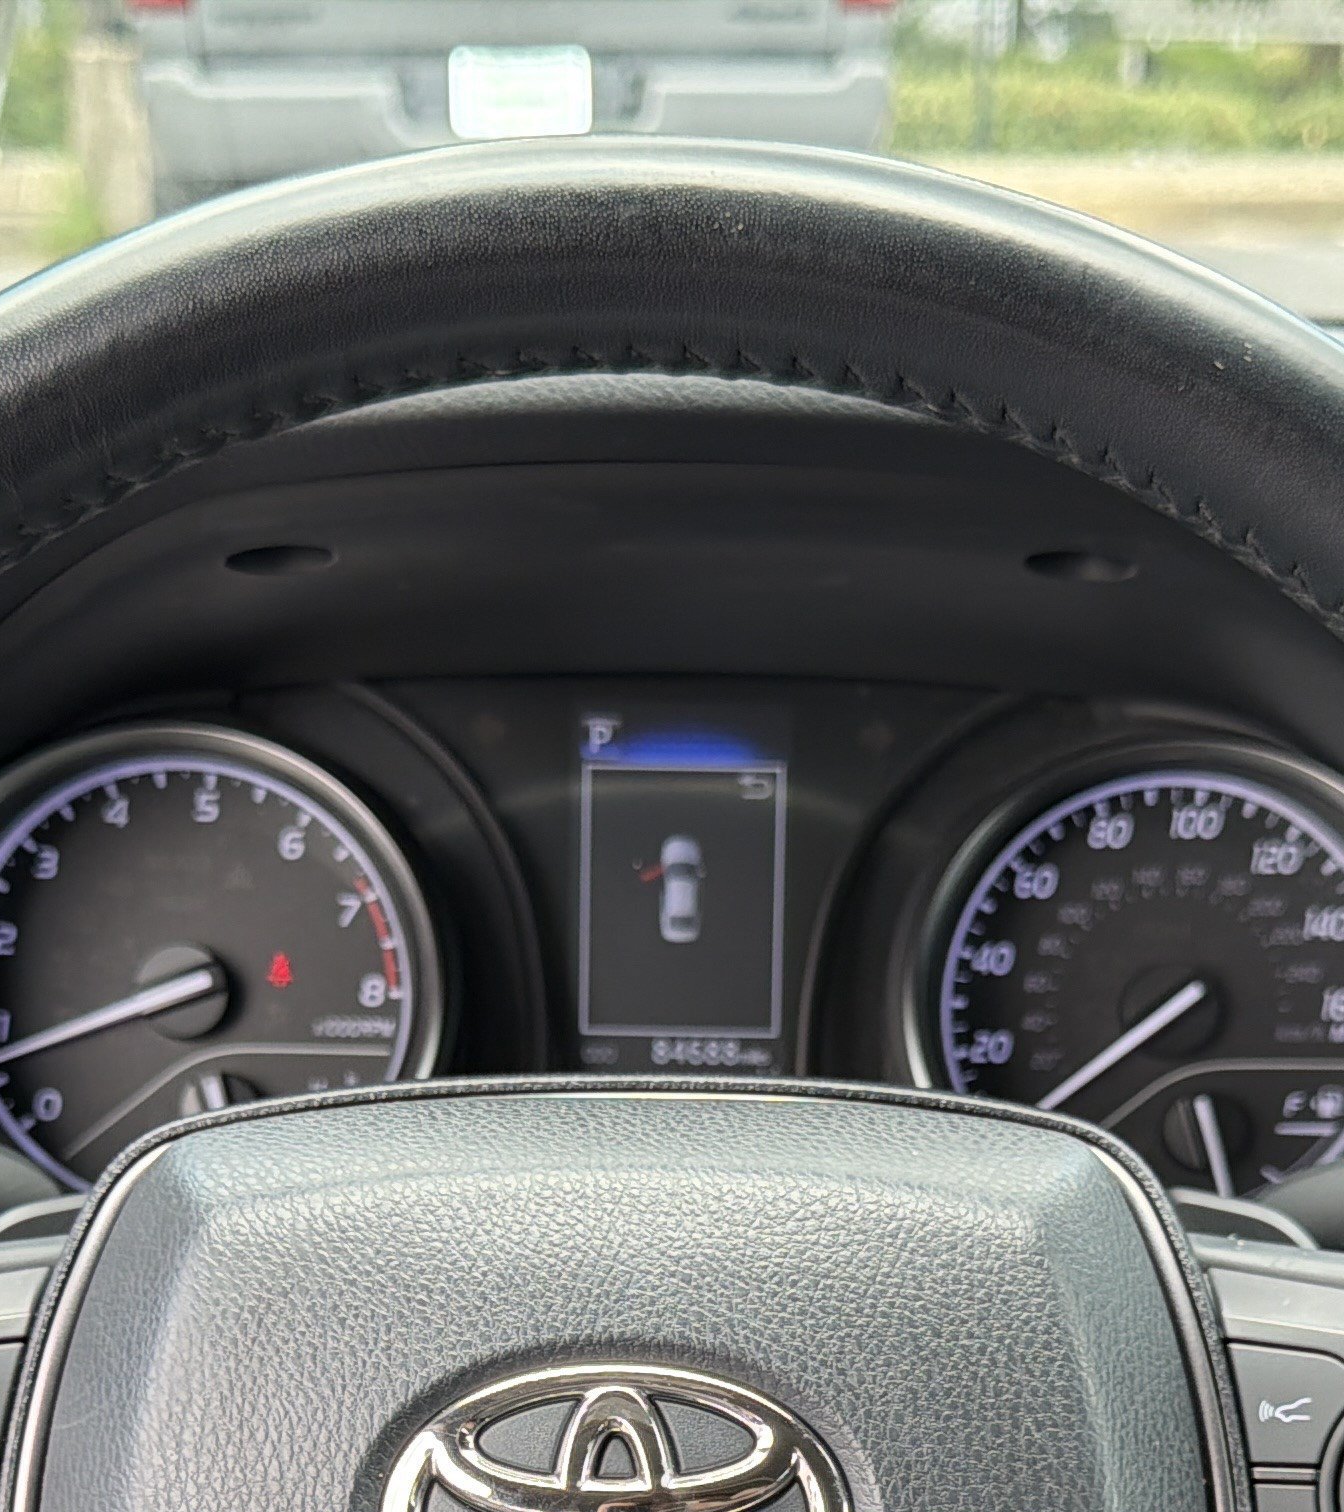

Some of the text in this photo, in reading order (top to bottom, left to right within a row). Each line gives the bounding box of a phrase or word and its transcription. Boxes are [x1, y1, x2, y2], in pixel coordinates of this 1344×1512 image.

[101, 798, 131, 830] 4
[193, 789, 221, 825] 5
[1170, 803, 1225, 841] 100
[278, 829, 305, 861] 6
[1087, 812, 1134, 850] 80
[31, 846, 60, 881] 3
[1251, 841, 1304, 876] 120
[1015, 862, 1059, 899] 60
[338, 893, 362, 928] 7
[972, 940, 1015, 976] 40
[358, 974, 386, 1008] 8
[969, 1028, 1014, 1064] 20
[32, 1087, 63, 1121] 0
